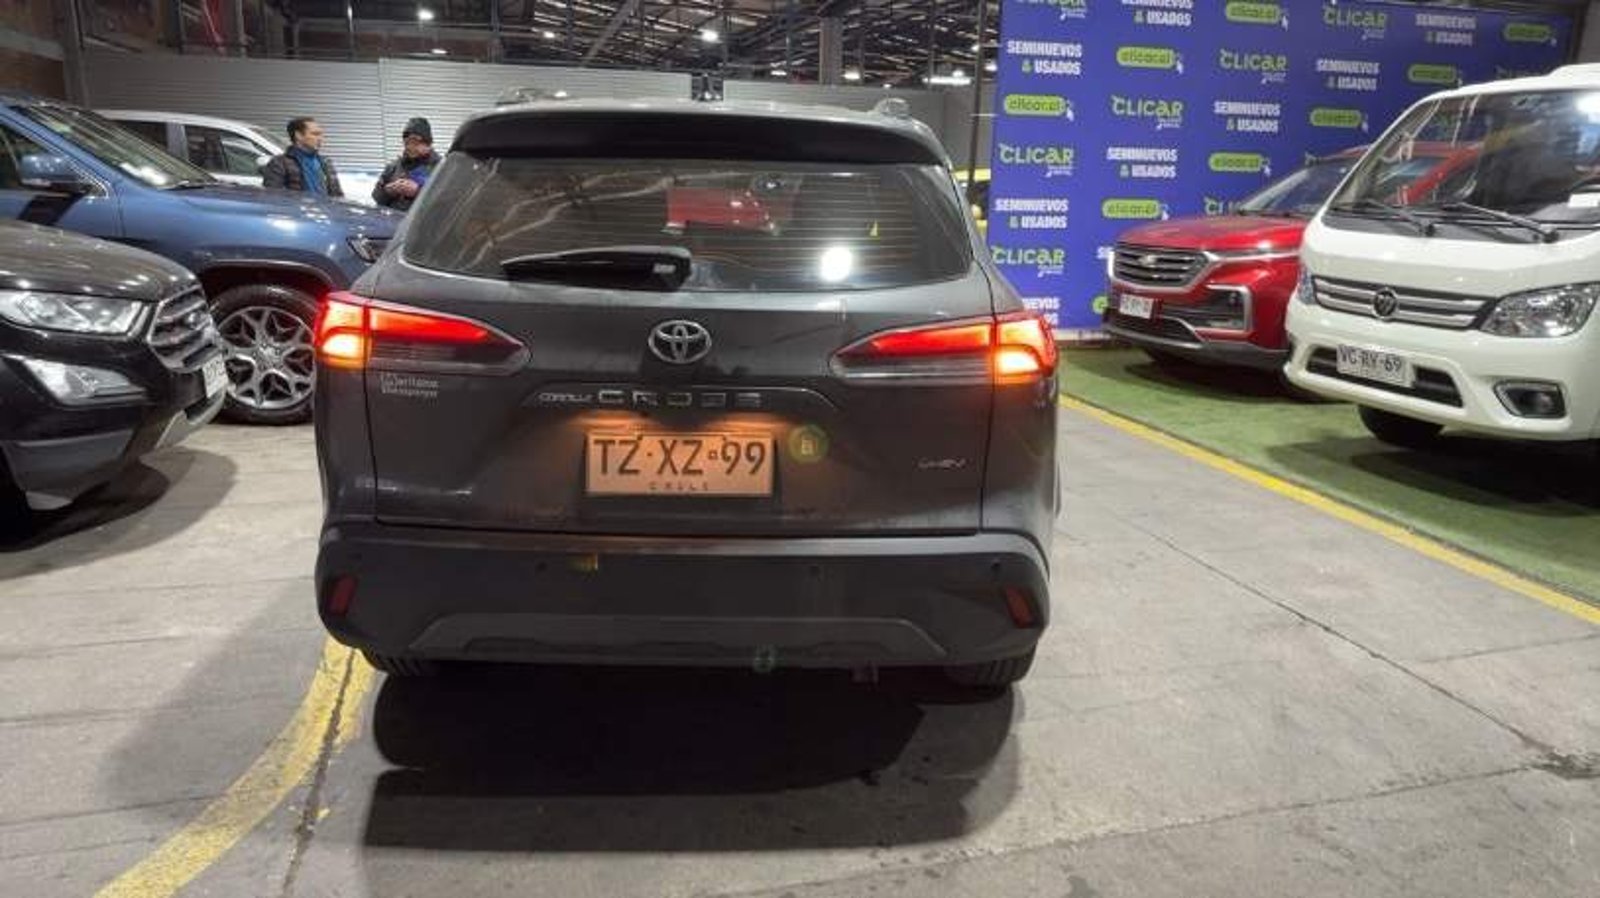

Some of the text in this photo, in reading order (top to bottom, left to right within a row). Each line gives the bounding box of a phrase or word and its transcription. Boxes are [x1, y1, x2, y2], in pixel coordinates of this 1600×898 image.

[1134, 11, 1192, 27] & USADOS
[1323, 7, 1387, 27] CLICAR
[1006, 40, 1083, 57] SEMINUEVOS
[1022, 60, 1082, 76] & USADOS
[1219, 48, 1287, 71] CLICAR
[1111, 95, 1184, 119] CLICAR
[1214, 101, 1281, 118] SEMINUEVOS
[1237, 118, 1279, 133] USADOS
[998, 143, 1075, 166] CLICAR
[1106, 147, 1178, 163] SEMINUEVOS
[1132, 163, 1177, 178] USADOS
[995, 198, 1070, 213] SEMINUEVOS
[1021, 214, 1067, 229] USADOS
[991, 245, 1064, 265] CLICAR
[598, 389, 762, 408] CROSS
